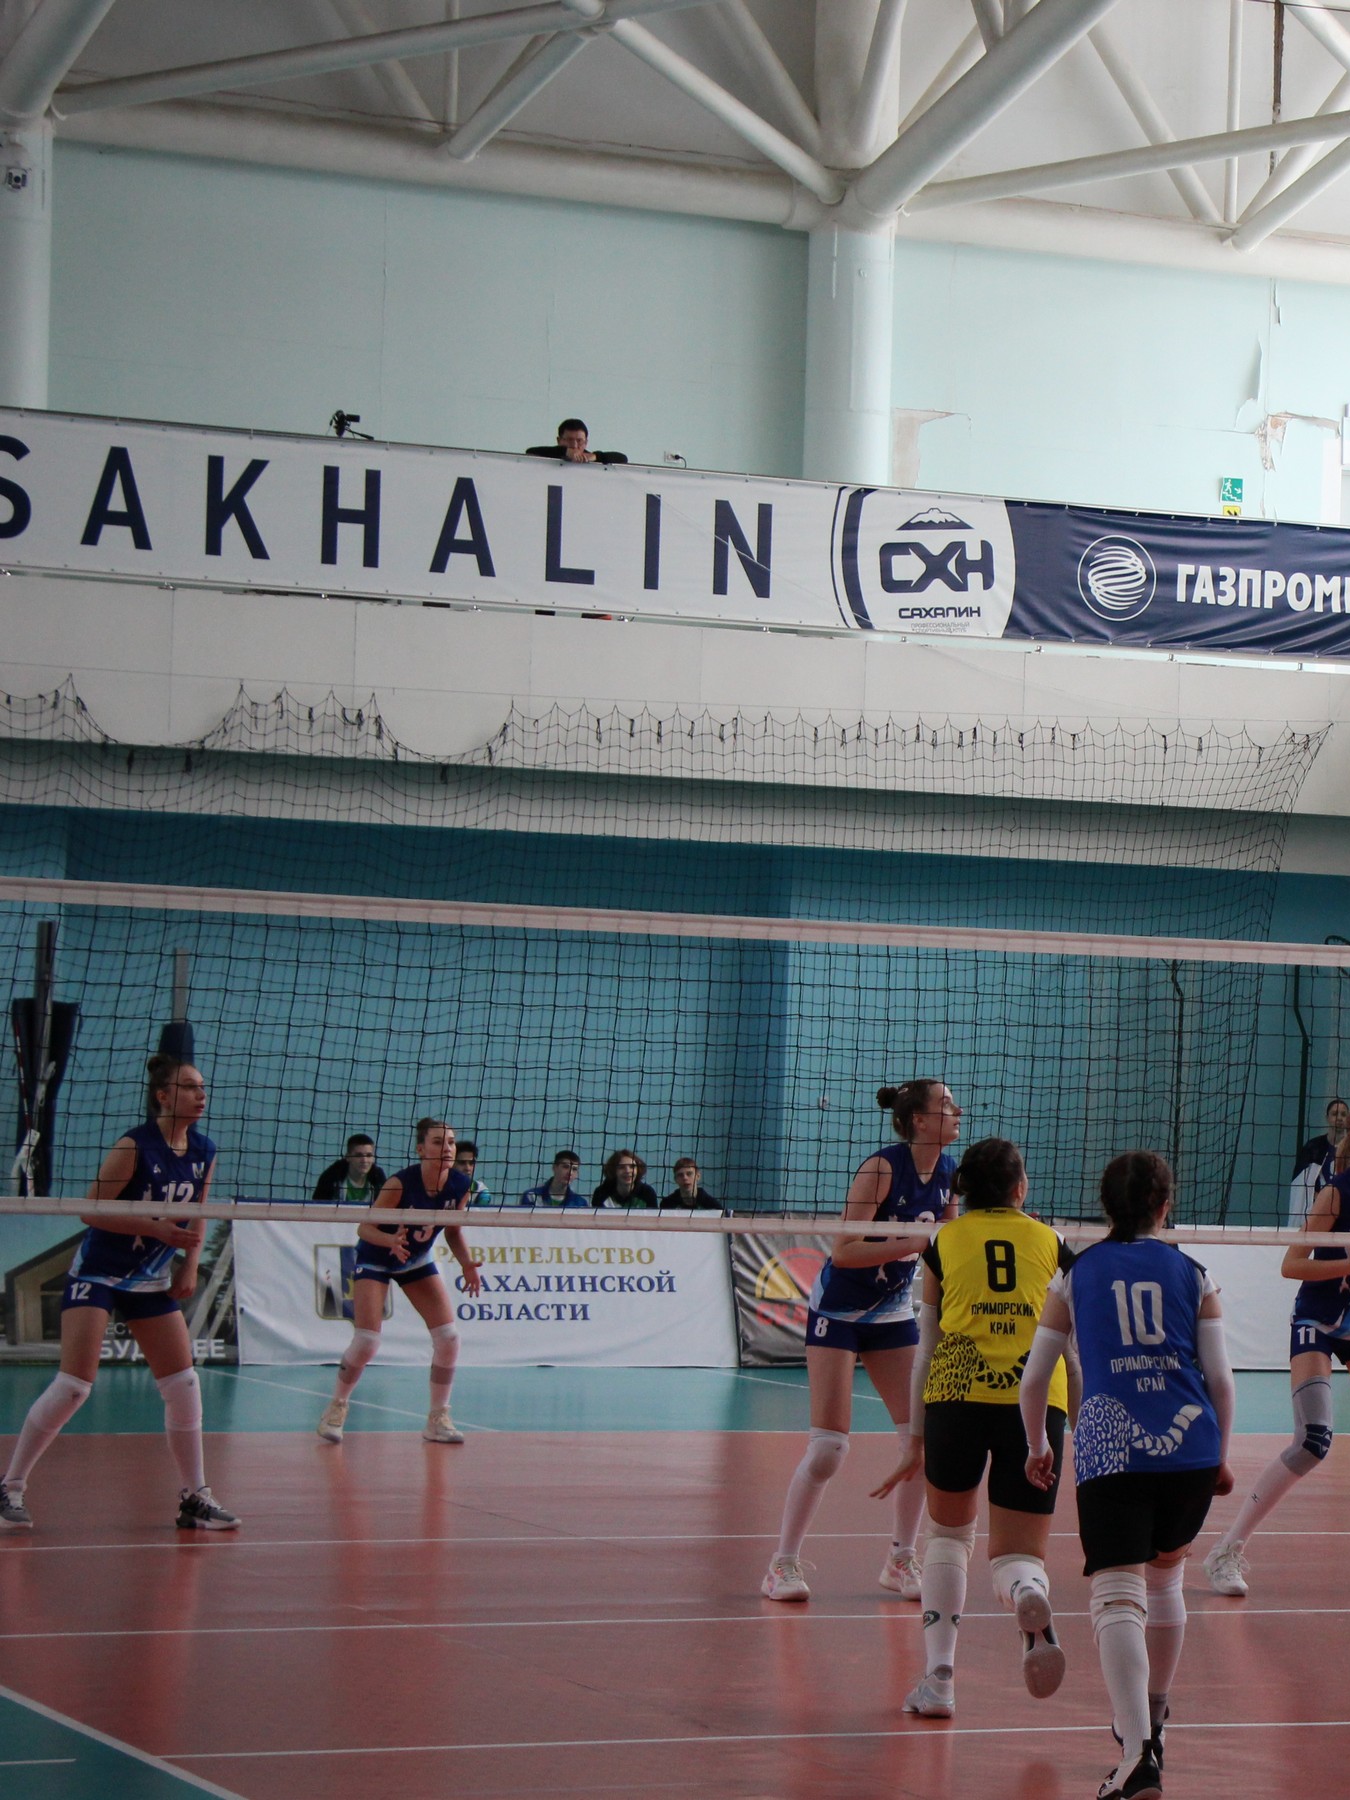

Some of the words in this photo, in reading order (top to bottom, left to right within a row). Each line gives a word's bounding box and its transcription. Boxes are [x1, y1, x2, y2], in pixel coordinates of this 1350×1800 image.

[0, 434, 772, 599] SAKHALIN
[435, 1246, 655, 1264] РВИТЕЛЬСТВО
[984, 1239, 1016, 1292] 8
[70, 1282, 90, 1300] 12
[457, 1303, 591, 1321] ОБЛАСТИ
[1110, 1280, 1166, 1346] 10
[814, 1316, 829, 1337] 8
[990, 1318, 1016, 1335] КРАЙ
[1297, 1326, 1316, 1344] 11
[99, 1339, 226, 1362] БУДЕЕ
[1110, 1352, 1181, 1374] ПРИМОРСКИЙ
[1136, 1372, 1166, 1392] КРАЙ
